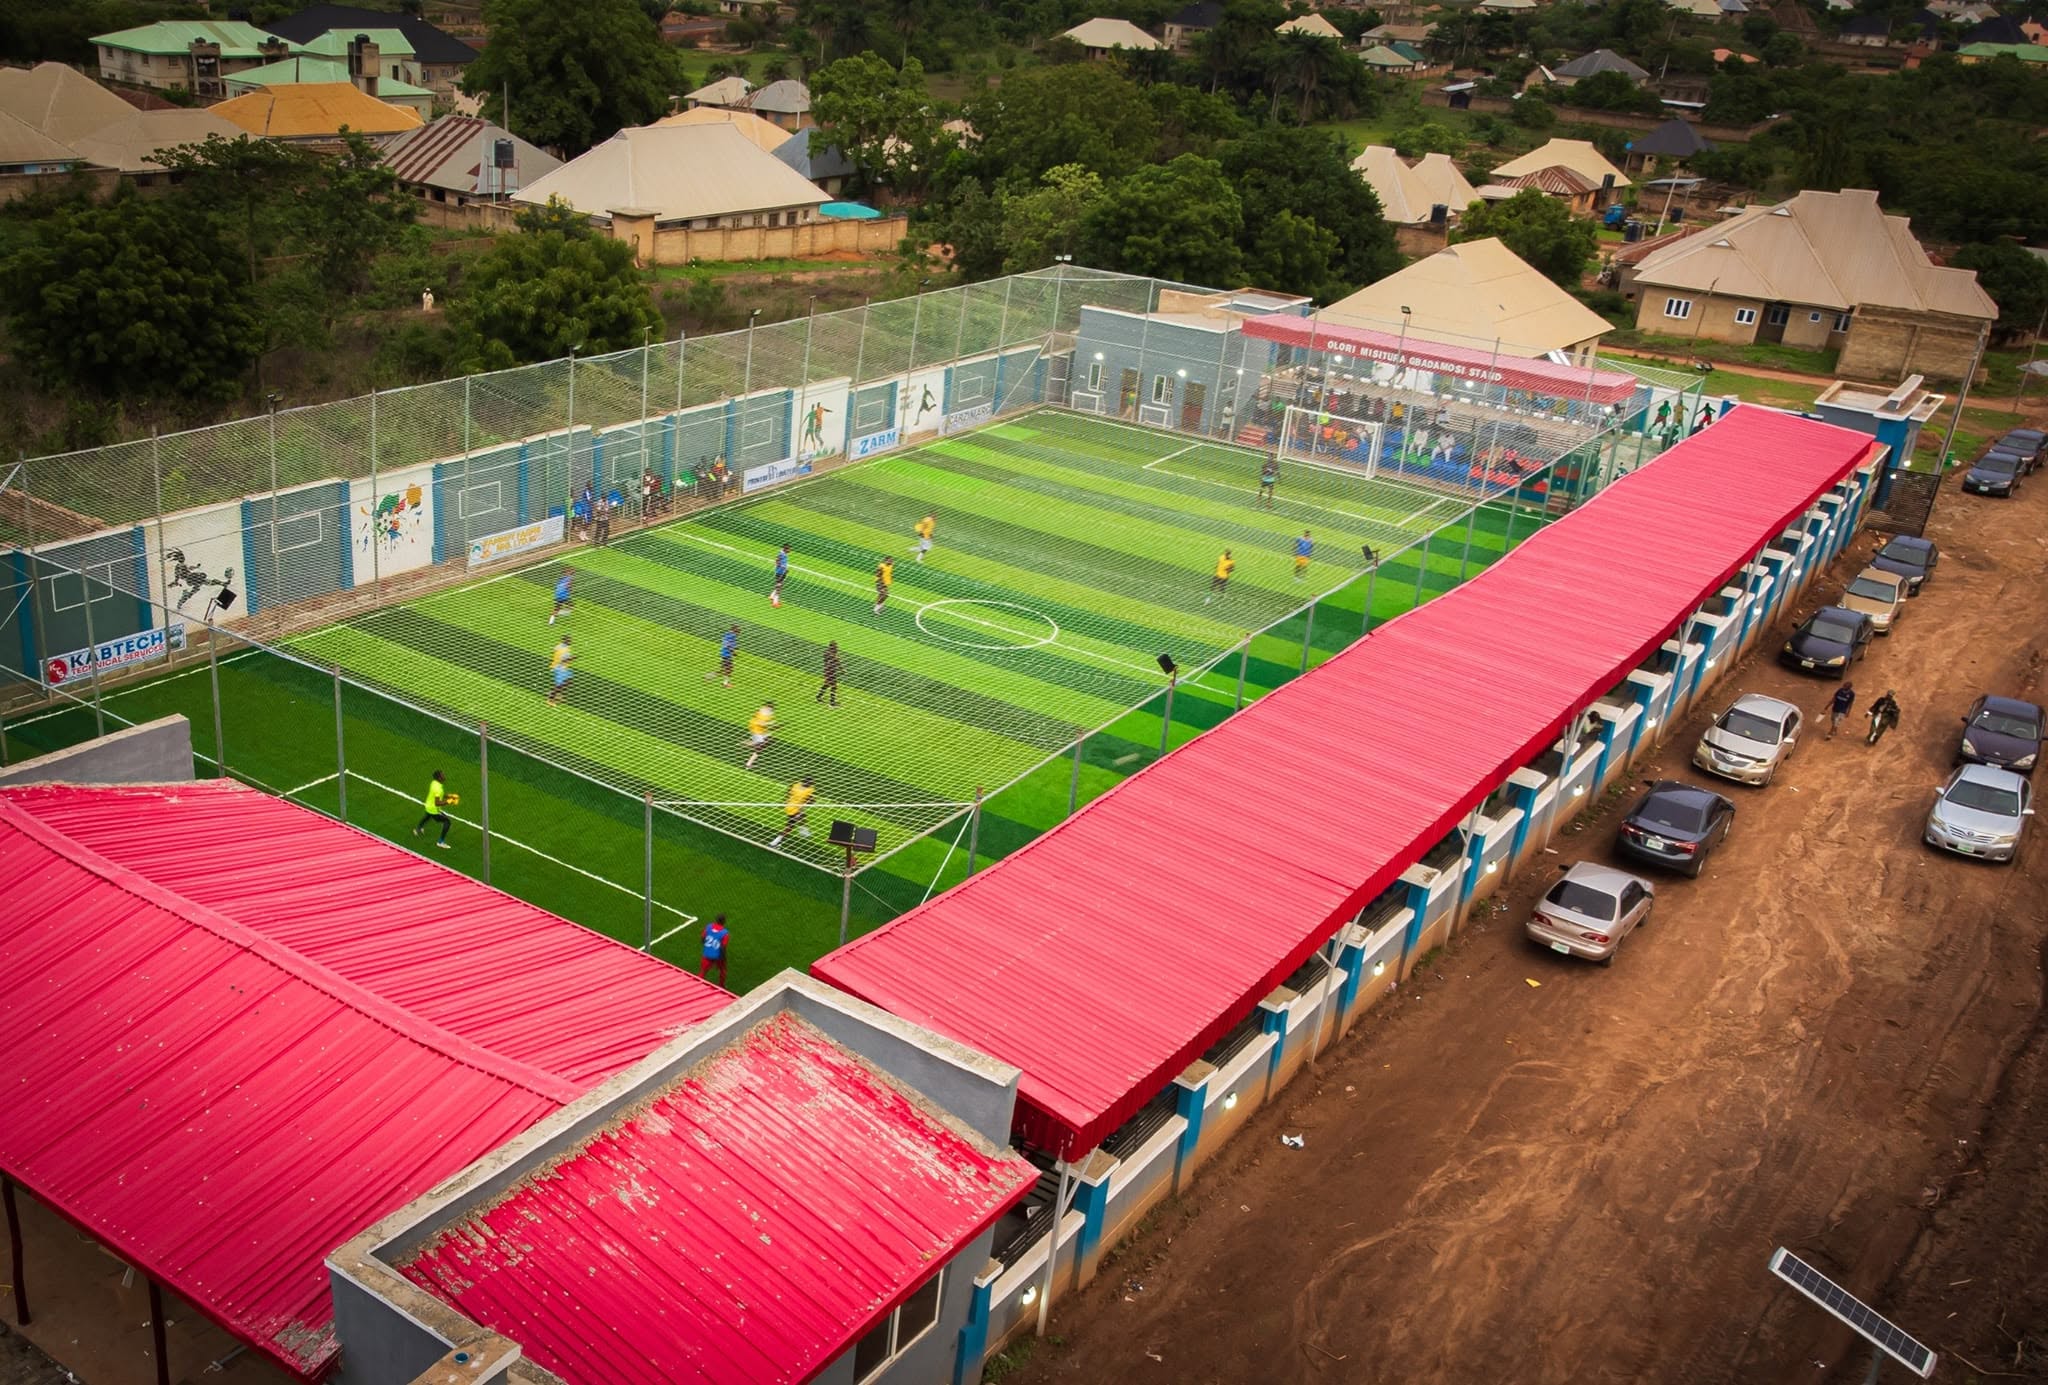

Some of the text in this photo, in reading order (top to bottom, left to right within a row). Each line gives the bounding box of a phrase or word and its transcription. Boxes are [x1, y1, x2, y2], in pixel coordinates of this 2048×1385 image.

[1327, 340, 1356, 354] OLORI
[1409, 356, 1465, 375] GBADAMOSI
[860, 431, 896, 455] ZARM
[70, 632, 163, 668] KABTECH
[72, 644, 164, 676] TECHNICAL SERVICES
